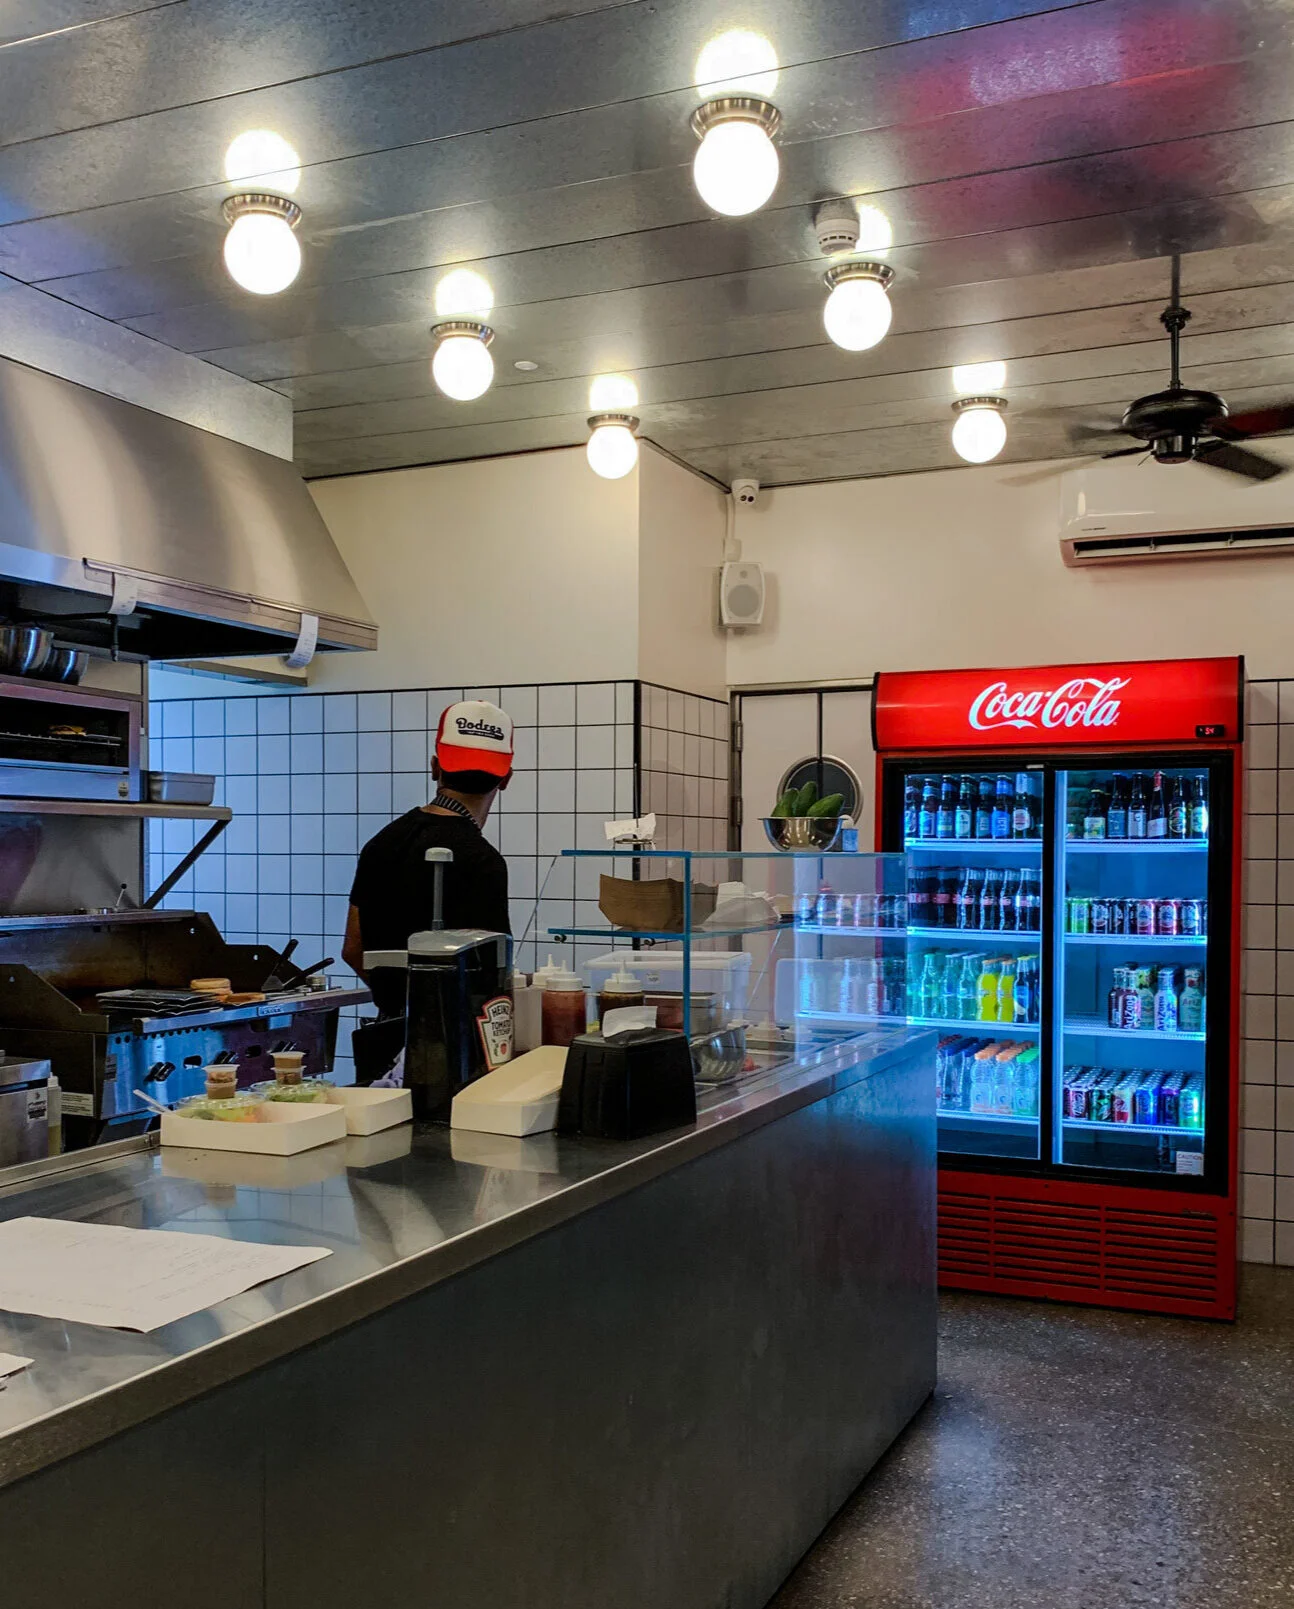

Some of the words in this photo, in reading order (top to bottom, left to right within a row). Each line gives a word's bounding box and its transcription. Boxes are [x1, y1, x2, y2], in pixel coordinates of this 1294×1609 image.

[968, 677, 1132, 730] Coca-Cola
[491, 1005, 510, 1017] HEINZ
[491, 1020, 511, 1030] TOMATO
